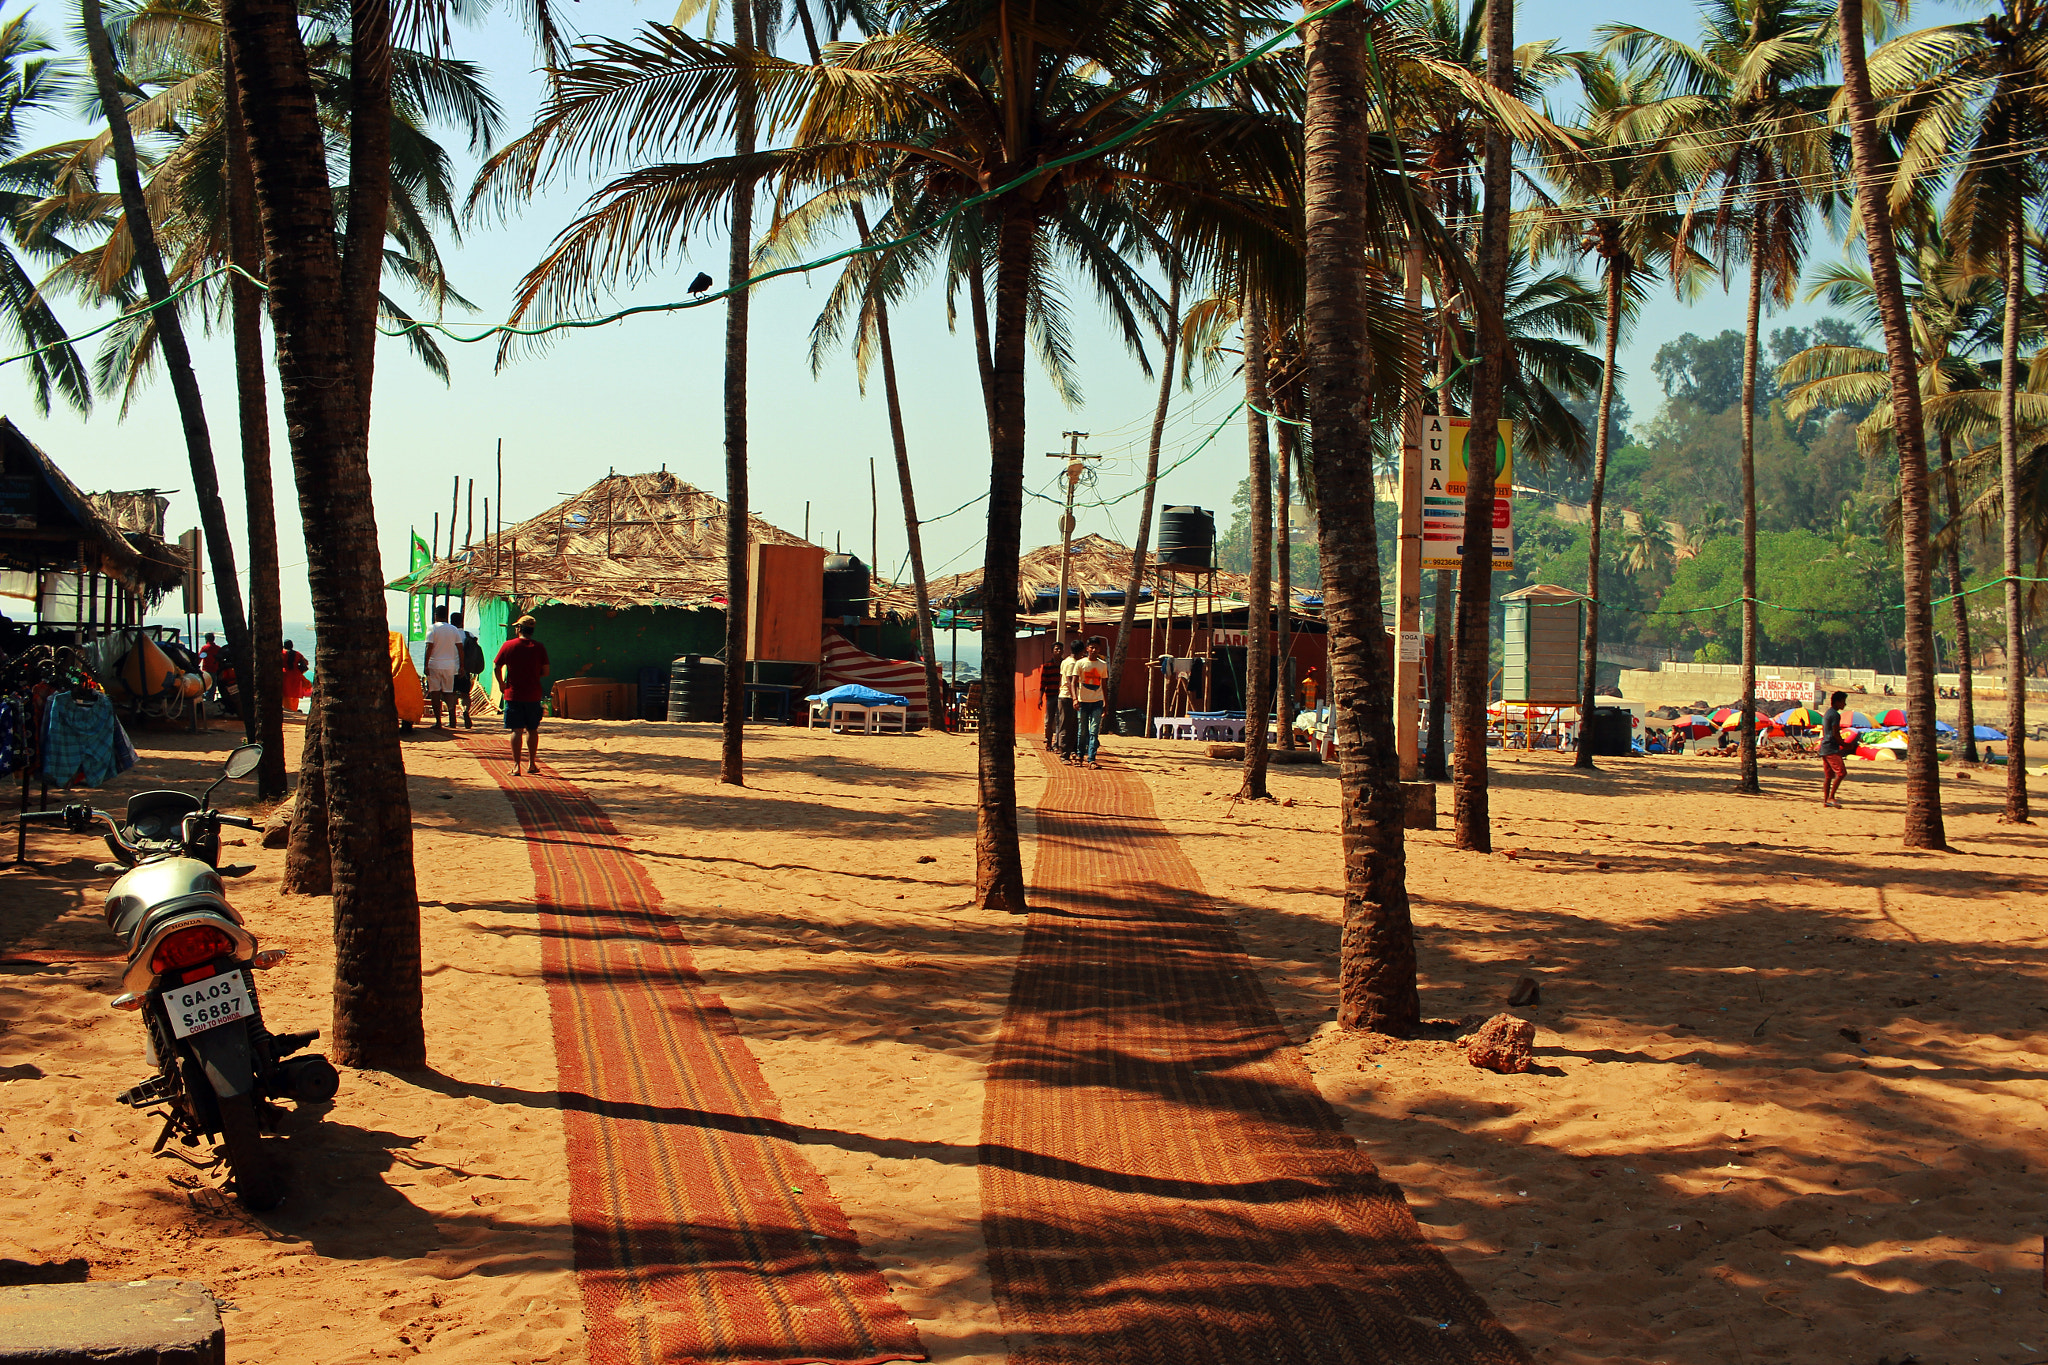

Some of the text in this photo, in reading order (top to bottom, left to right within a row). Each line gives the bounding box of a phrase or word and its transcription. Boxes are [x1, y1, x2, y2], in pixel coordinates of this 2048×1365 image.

[1430, 419, 1442, 491] AURA
[1447, 484, 1511, 496] PHOPHY
[1768, 681, 1784, 690] BEACH
[1785, 681, 1804, 691] SHACK
[1756, 690, 1813, 701] PARADISE BEACH
[171, 919, 202, 930] HONDA
[207, 1020, 217, 1028] TO
[218, 1012, 241, 1024] HONDA
